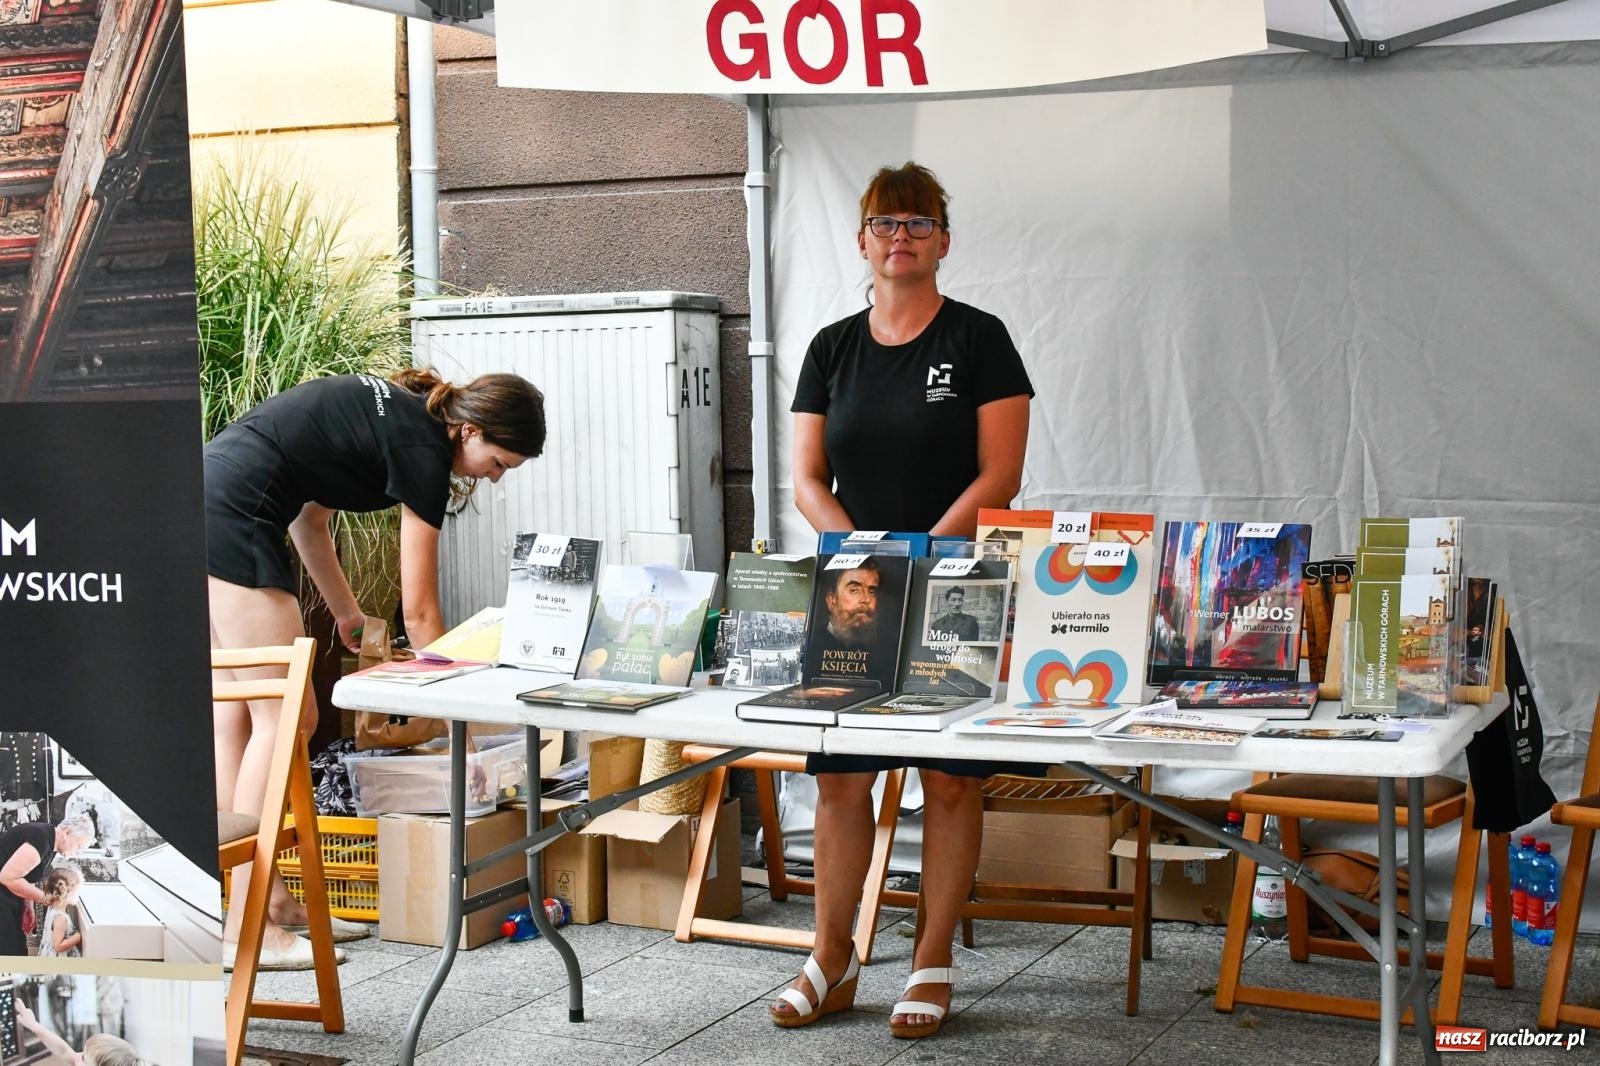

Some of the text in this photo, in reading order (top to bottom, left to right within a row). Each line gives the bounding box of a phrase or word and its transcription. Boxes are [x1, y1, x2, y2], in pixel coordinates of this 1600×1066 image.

[681, 366, 711, 409] A1E
[1057, 523, 1087, 533] 20 zł
[535, 545, 562, 556] 30 zł
[1094, 550, 1111, 558] 40
[1113, 549, 1125, 558] zł
[535, 593, 566, 605] Rok 1919
[1052, 610, 1093, 621] Ubierało
[1194, 605, 1295, 621] Werner LUBOS
[1069, 622, 1110, 633] tarmilo
[1242, 622, 1293, 633] malarstwo
[928, 629, 960, 645] Moja
[930, 642, 970, 654] droga do
[1377, 589, 1390, 700] W TARNOWSKICH GÓRACH
[616, 650, 630, 663] Był
[631, 653, 654, 663] sobie
[823, 649, 870, 661] POWRÓT
[936, 652, 984, 664] wolności
[611, 660, 652, 676] pałac
[821, 660, 868, 675] KSIĘCIA
[914, 668, 947, 678] młodych
[930, 676, 940, 686] lat
[1365, 663, 1375, 700] MUZEUM
